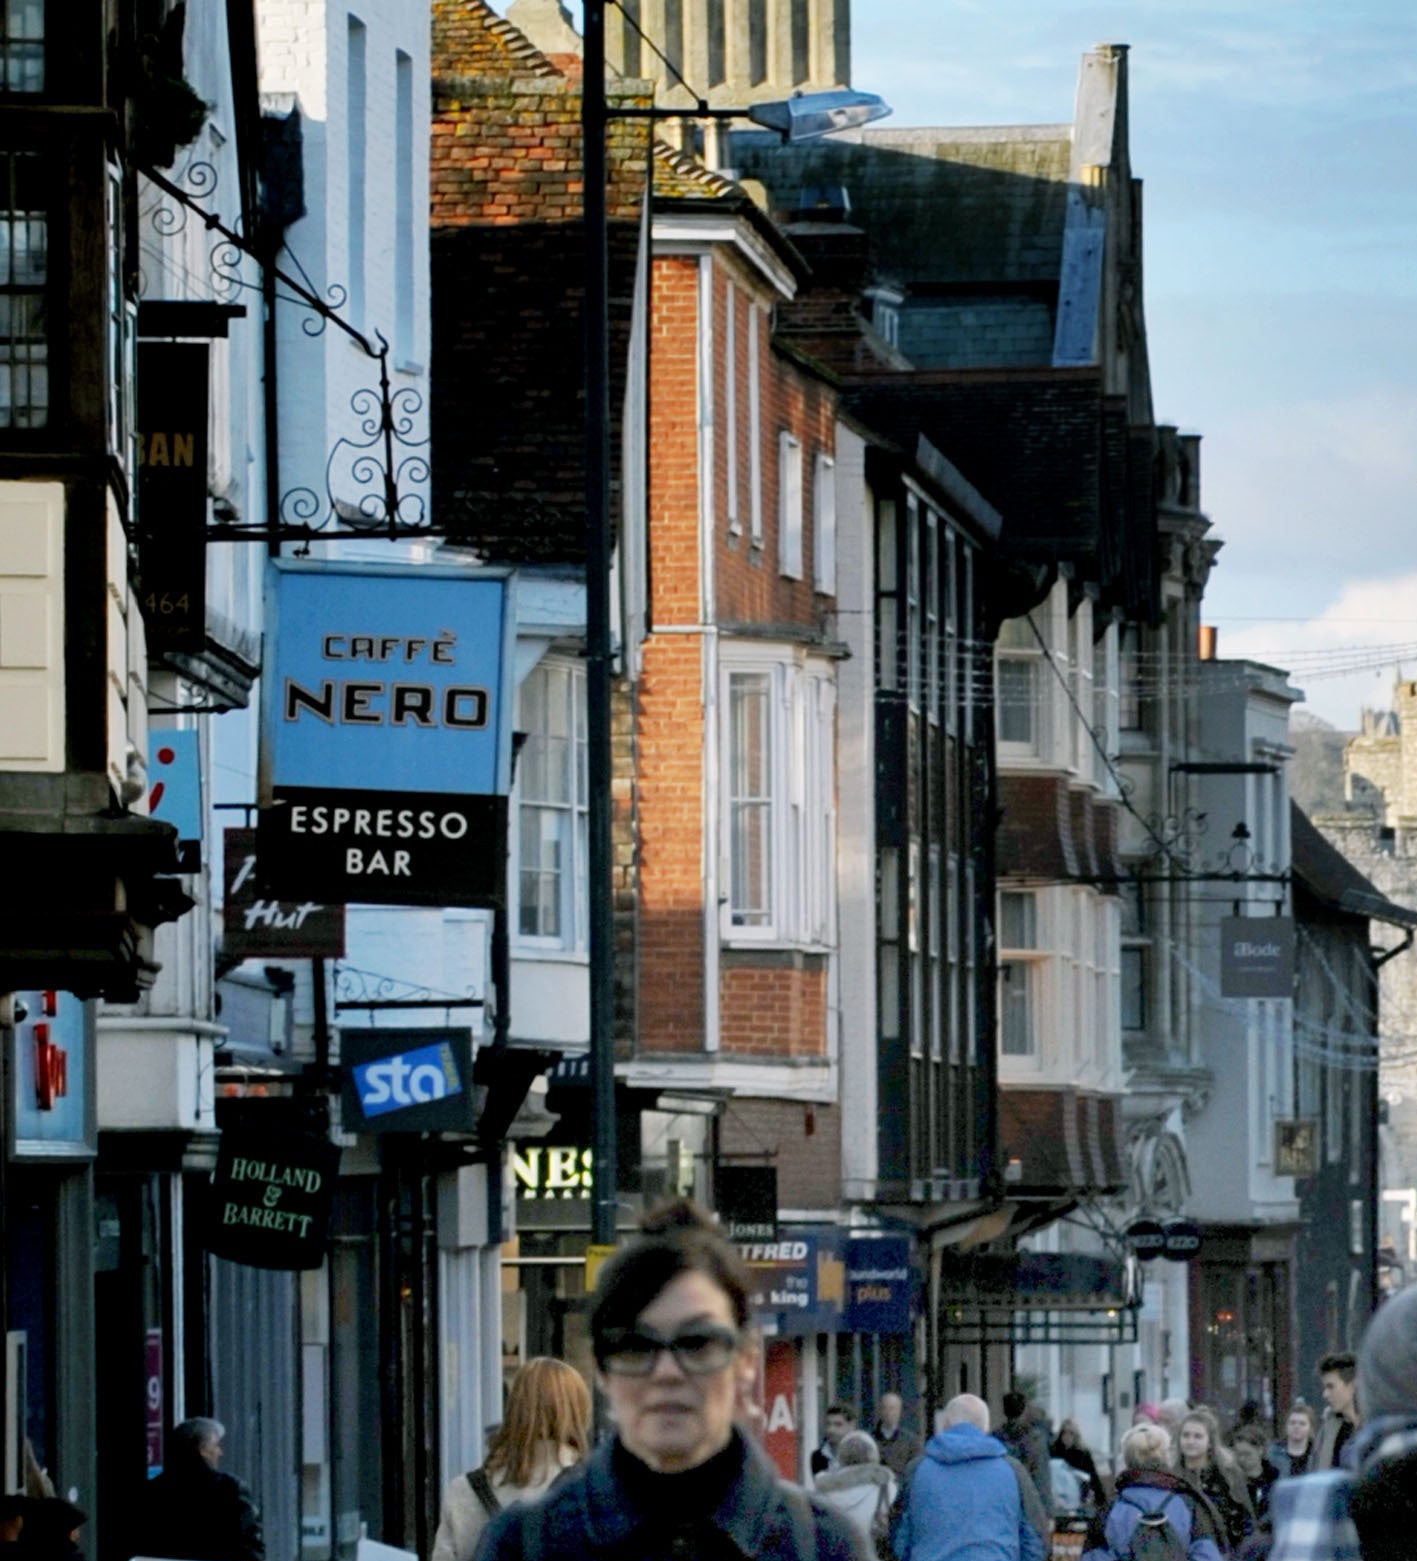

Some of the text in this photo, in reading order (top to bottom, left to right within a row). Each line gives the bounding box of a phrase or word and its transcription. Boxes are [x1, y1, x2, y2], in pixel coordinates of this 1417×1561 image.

[284, 676, 490, 730] NERO
[290, 806, 468, 839] ESPRESSO
[346, 848, 412, 876] BAR
[244, 900, 324, 929] Hut
[364, 1056, 445, 1104] sta
[231, 1158, 321, 1193] HOLLAND
[263, 1185, 282, 1207] &
[223, 1202, 313, 1238] BARRETT
[729, 1222, 774, 1237] JONES
